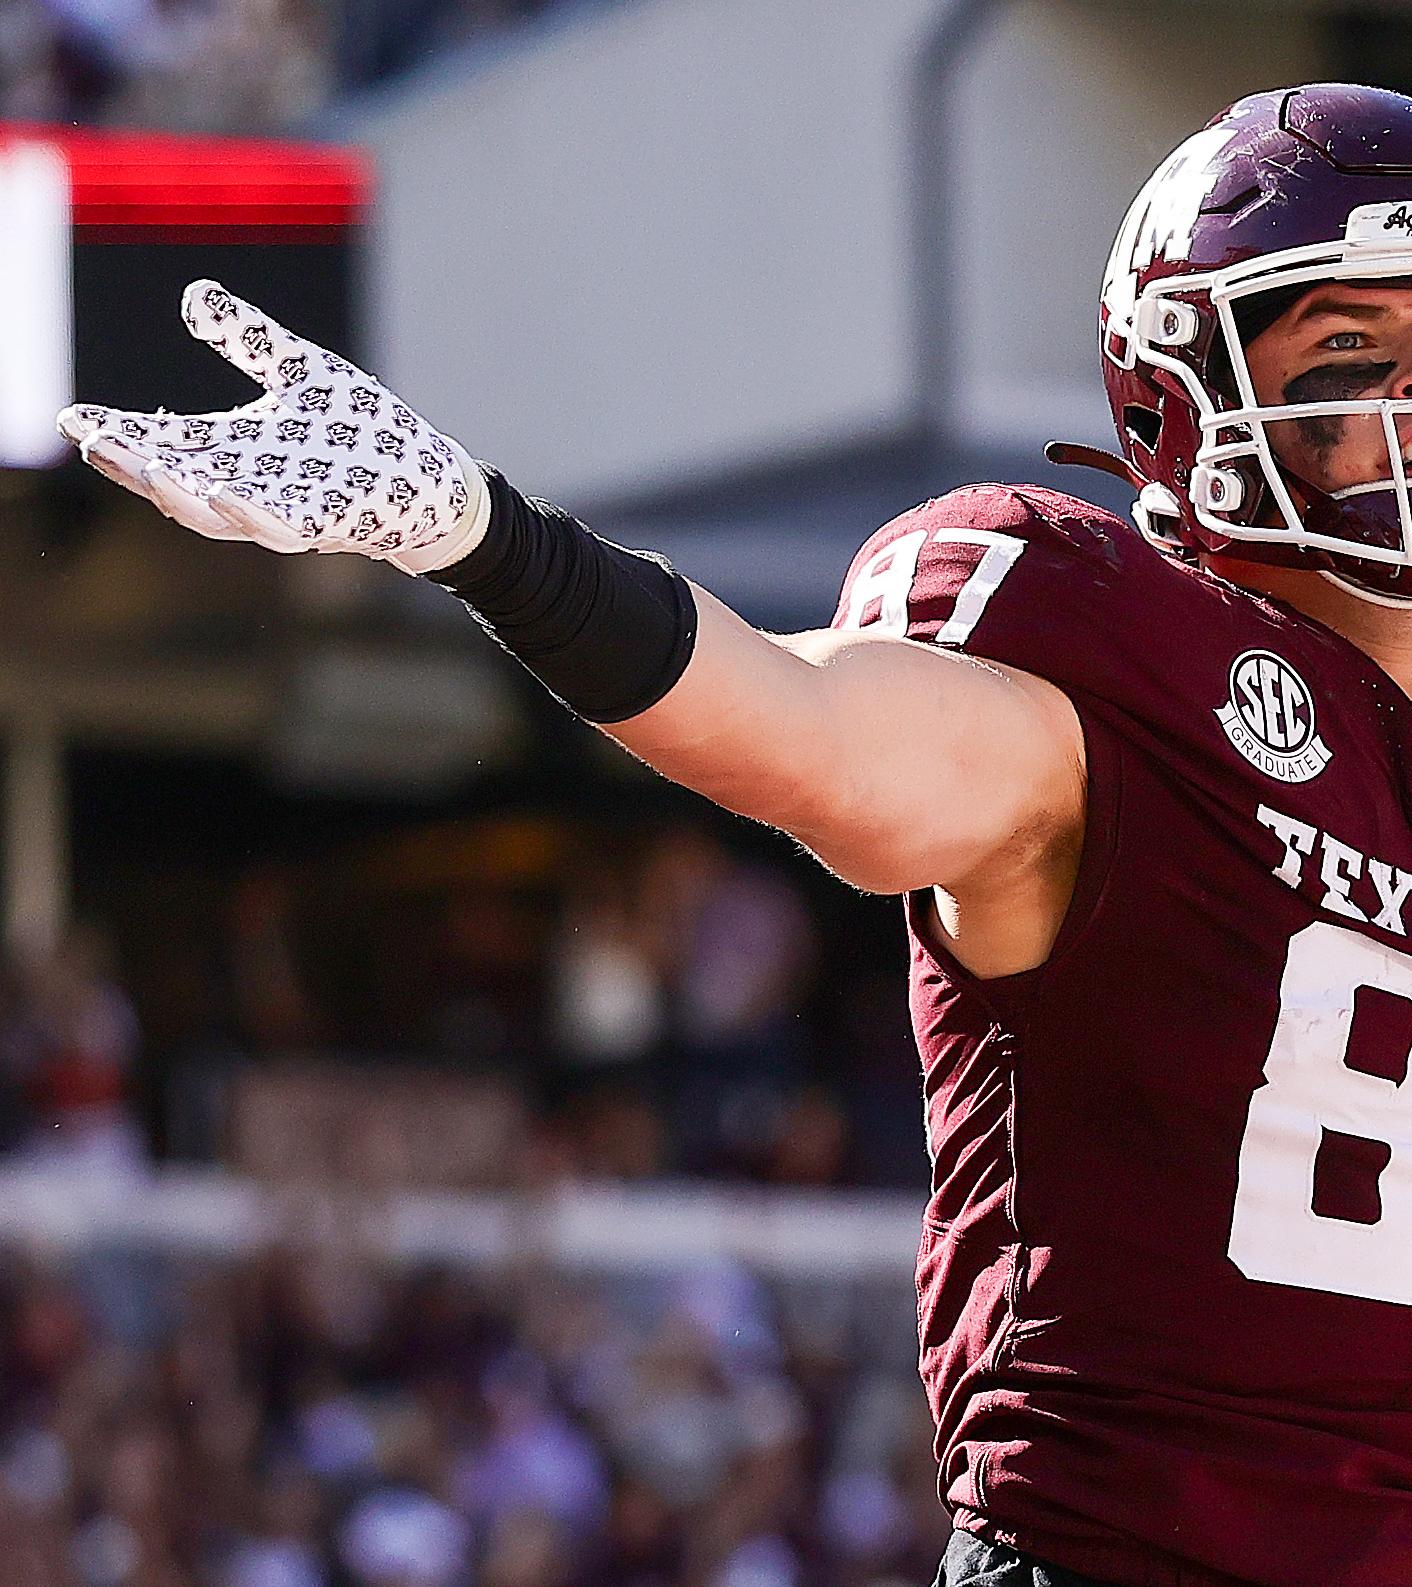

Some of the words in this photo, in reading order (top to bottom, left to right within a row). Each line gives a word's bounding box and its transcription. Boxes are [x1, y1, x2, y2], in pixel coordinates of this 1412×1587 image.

[840, 527, 1029, 646] 87
[1236, 658, 1307, 748] SEC
[1231, 727, 1318, 778] GRADUATE
